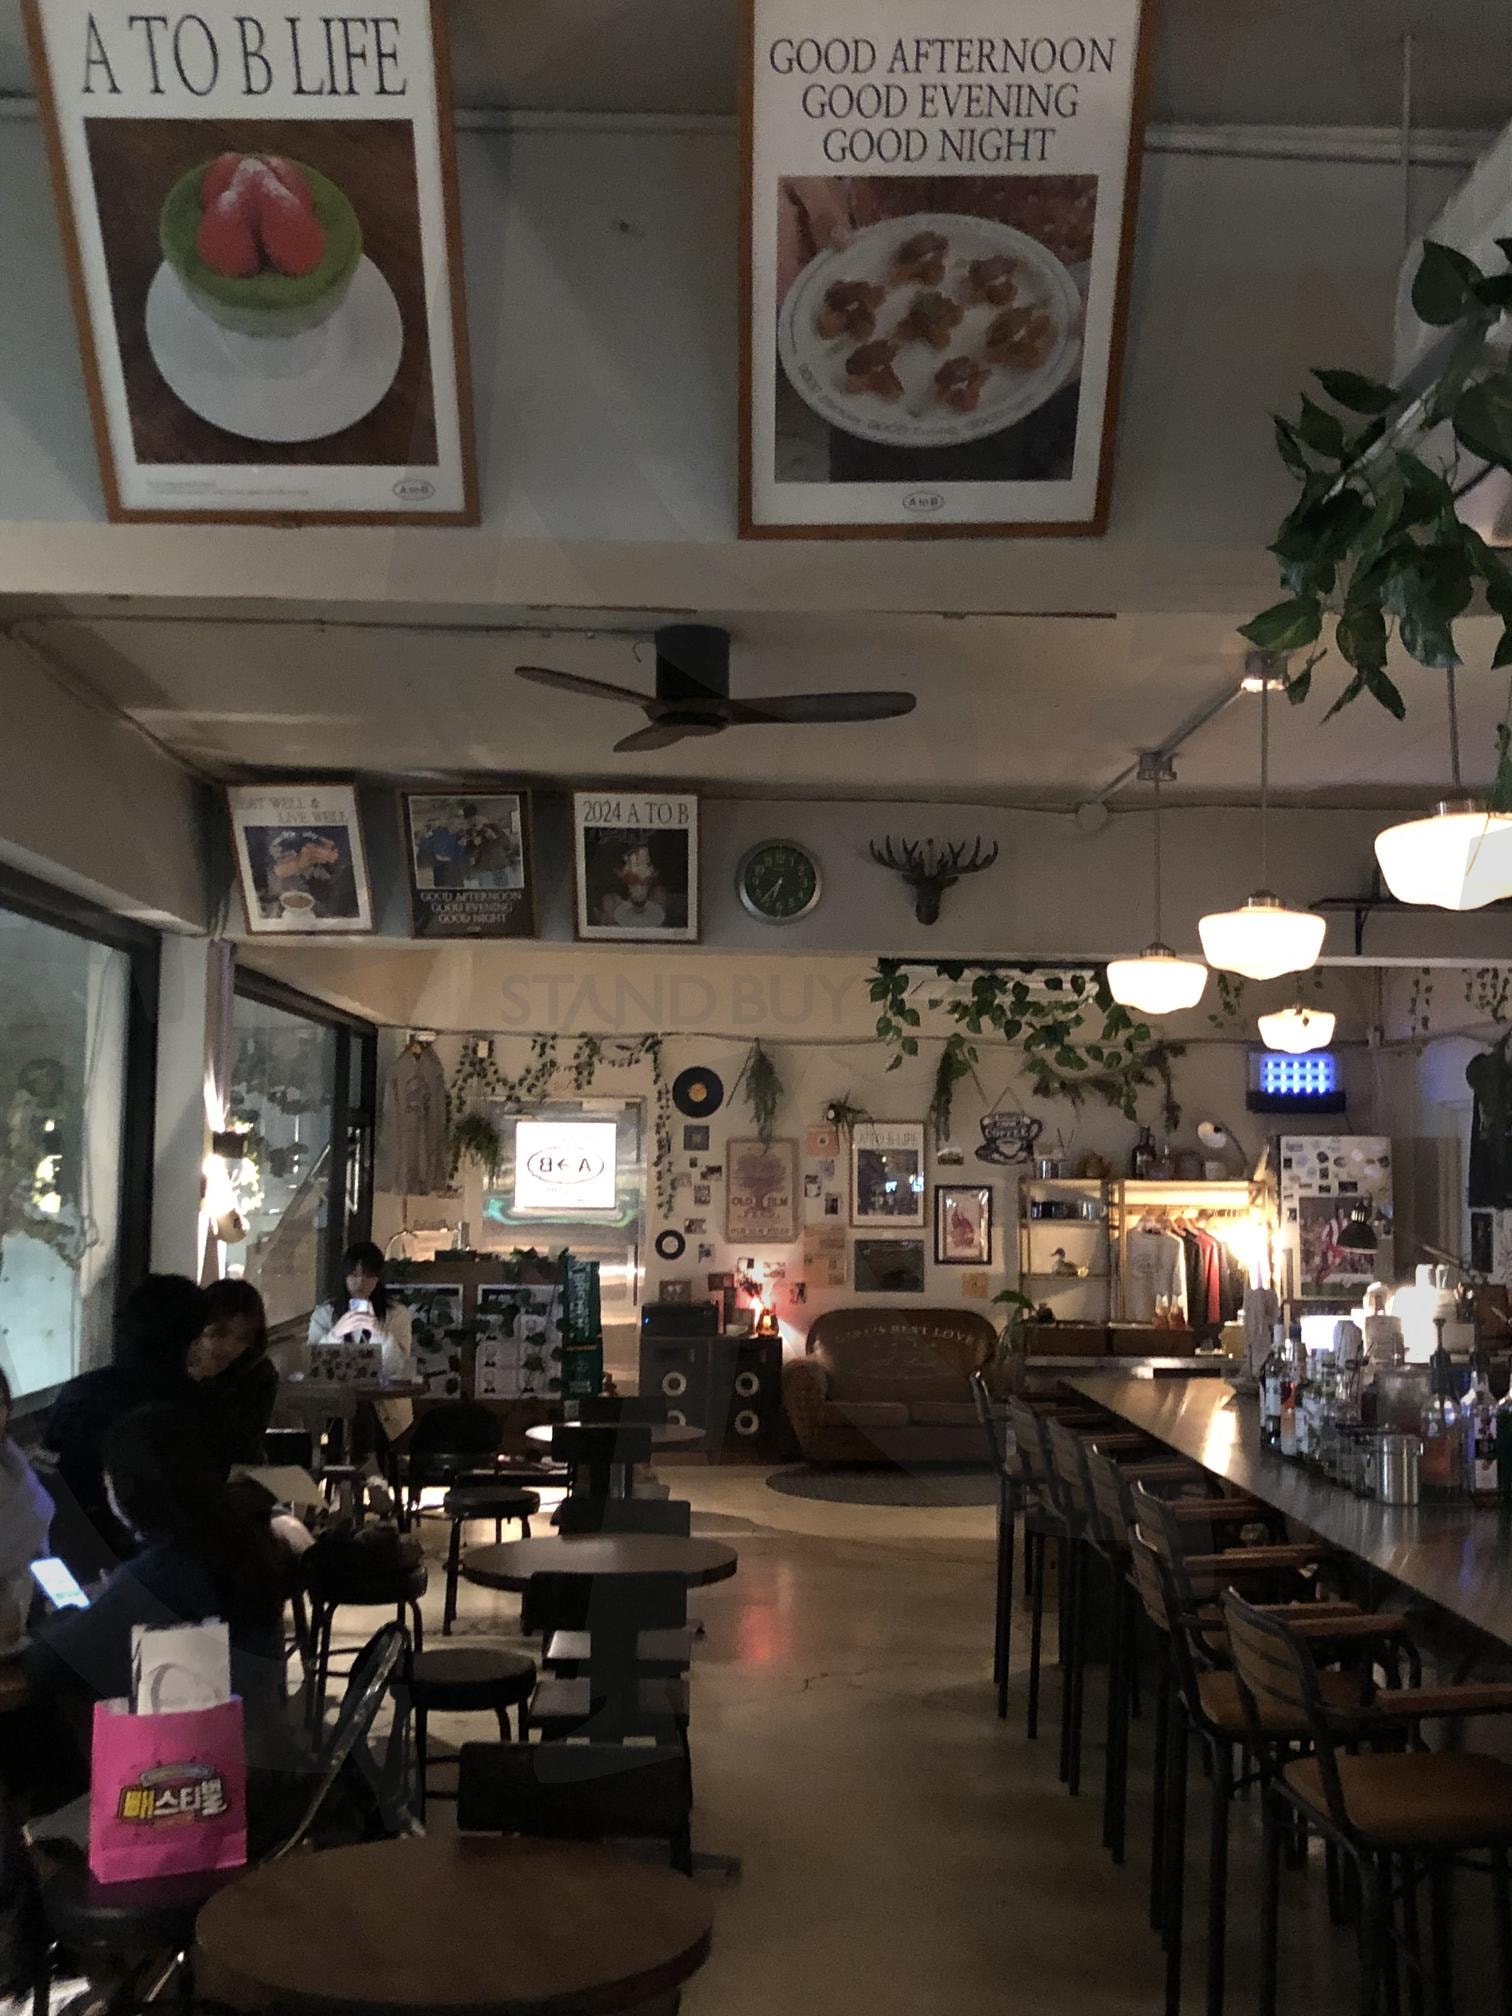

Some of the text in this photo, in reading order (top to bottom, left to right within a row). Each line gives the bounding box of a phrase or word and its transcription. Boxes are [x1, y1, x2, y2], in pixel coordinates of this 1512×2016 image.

[82, 12, 407, 96] A TO B LIFE
[769, 37, 1116, 74] GOOD AFTERNOON
[802, 83, 1079, 119] GOOD EVENING
[823, 128, 1056, 163] GOOD NIGHT
[583, 800, 689, 824] 2024 A TO B
[420, 891, 522, 902] GOOD AFTERNOON
[431, 903, 512, 913] GOOD EVENING
[438, 914, 506, 924] GOOD NIGHT
[732, 1196, 752, 1207] OLD
[933, 1326, 975, 1346] LOVE
